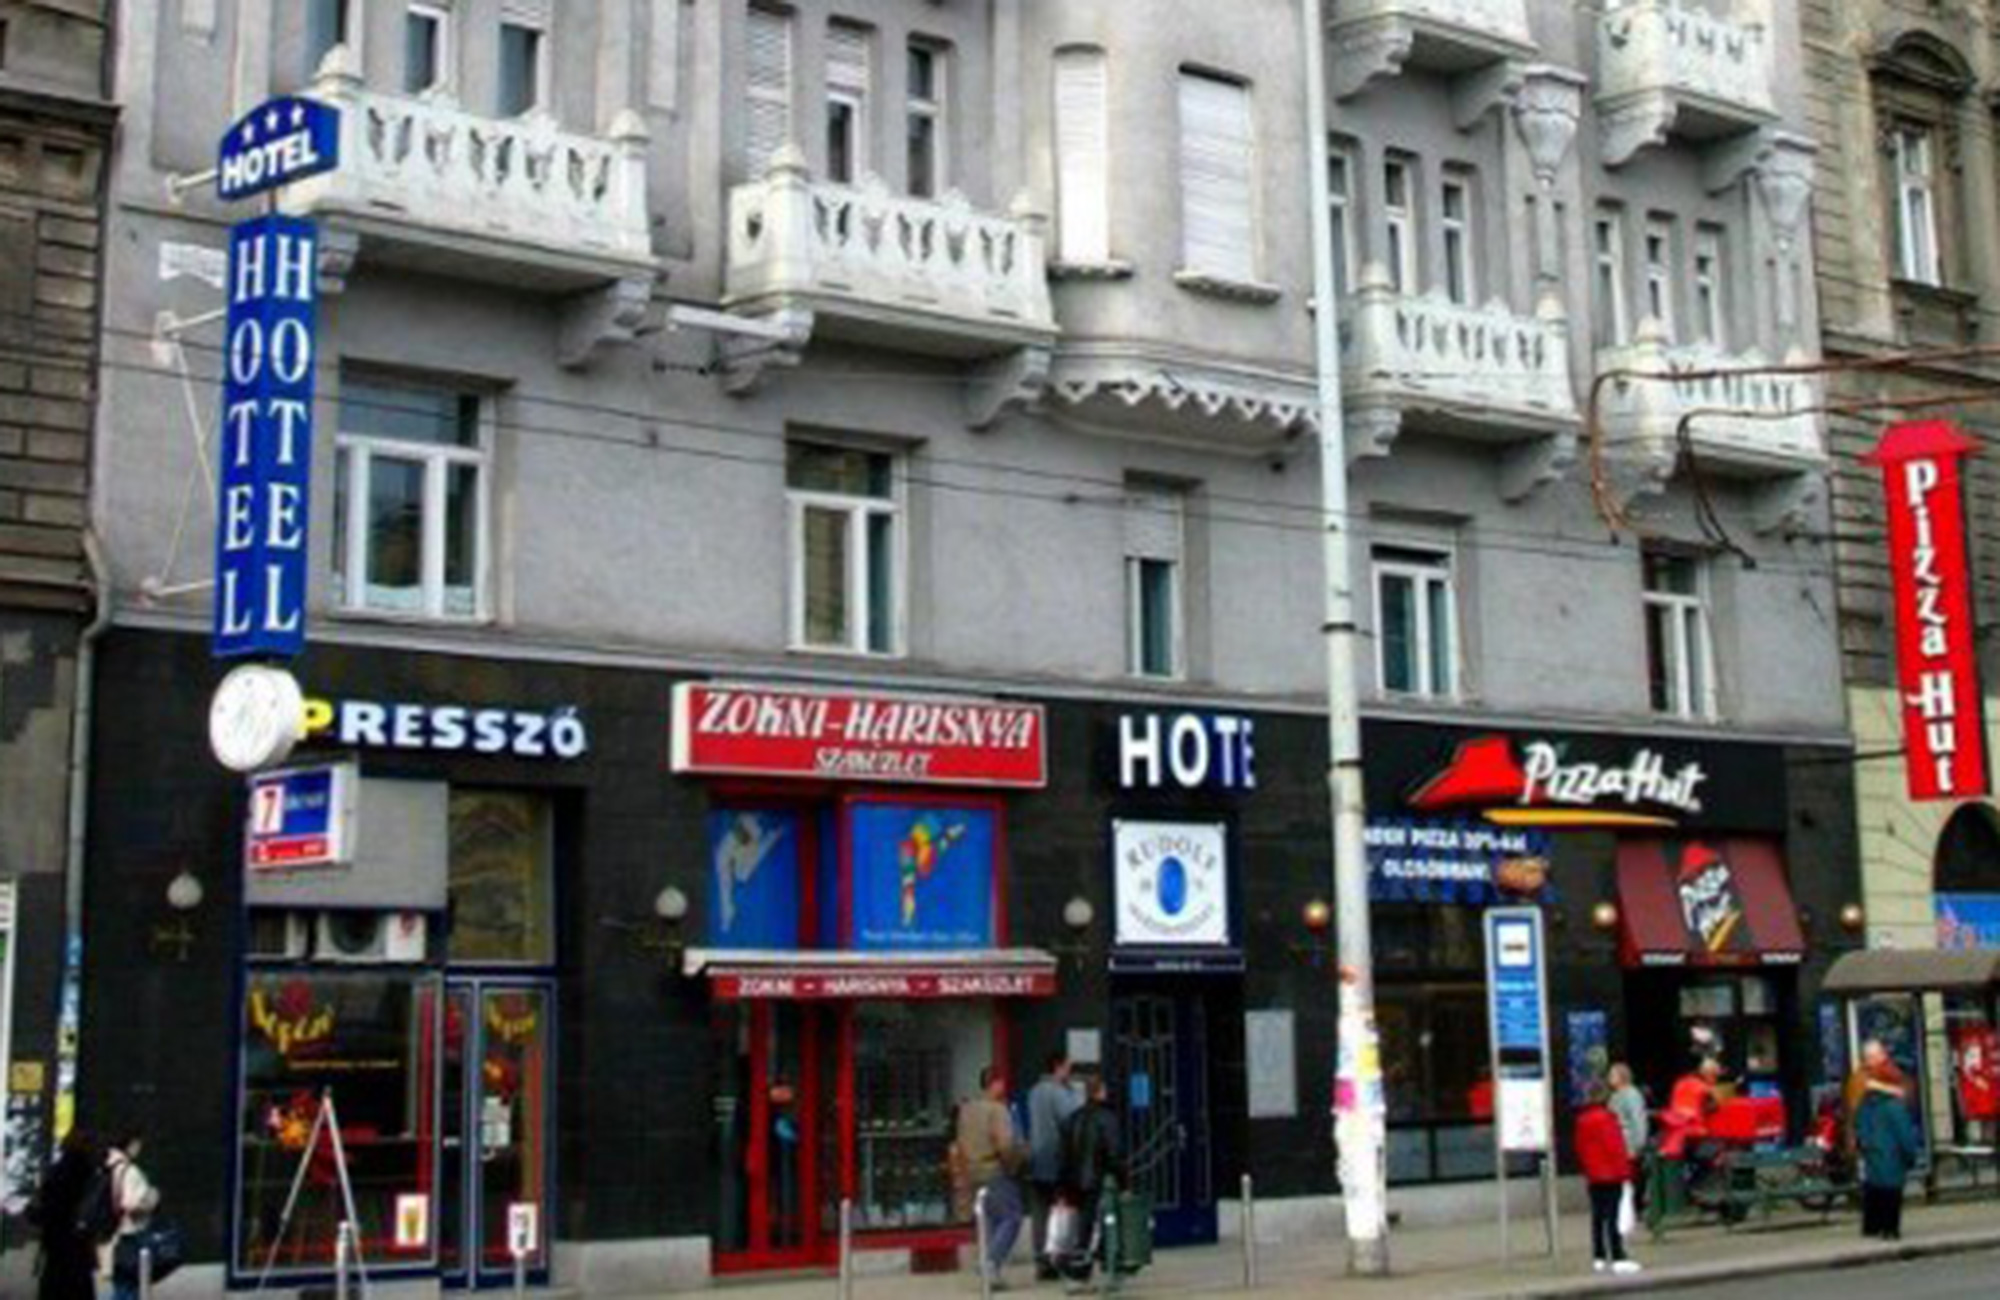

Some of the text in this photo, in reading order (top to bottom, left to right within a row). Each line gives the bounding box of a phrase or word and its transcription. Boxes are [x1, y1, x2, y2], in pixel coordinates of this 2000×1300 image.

[221, 128, 319, 193] HOTEL
[221, 235, 267, 636] HOTEL
[263, 234, 314, 632] HOTEL
[698, 692, 1036, 749] ZOKNI-HARISNYA
[1904, 459, 1956, 792] Pizza Hut
[296, 698, 586, 757] PRESSZÓ
